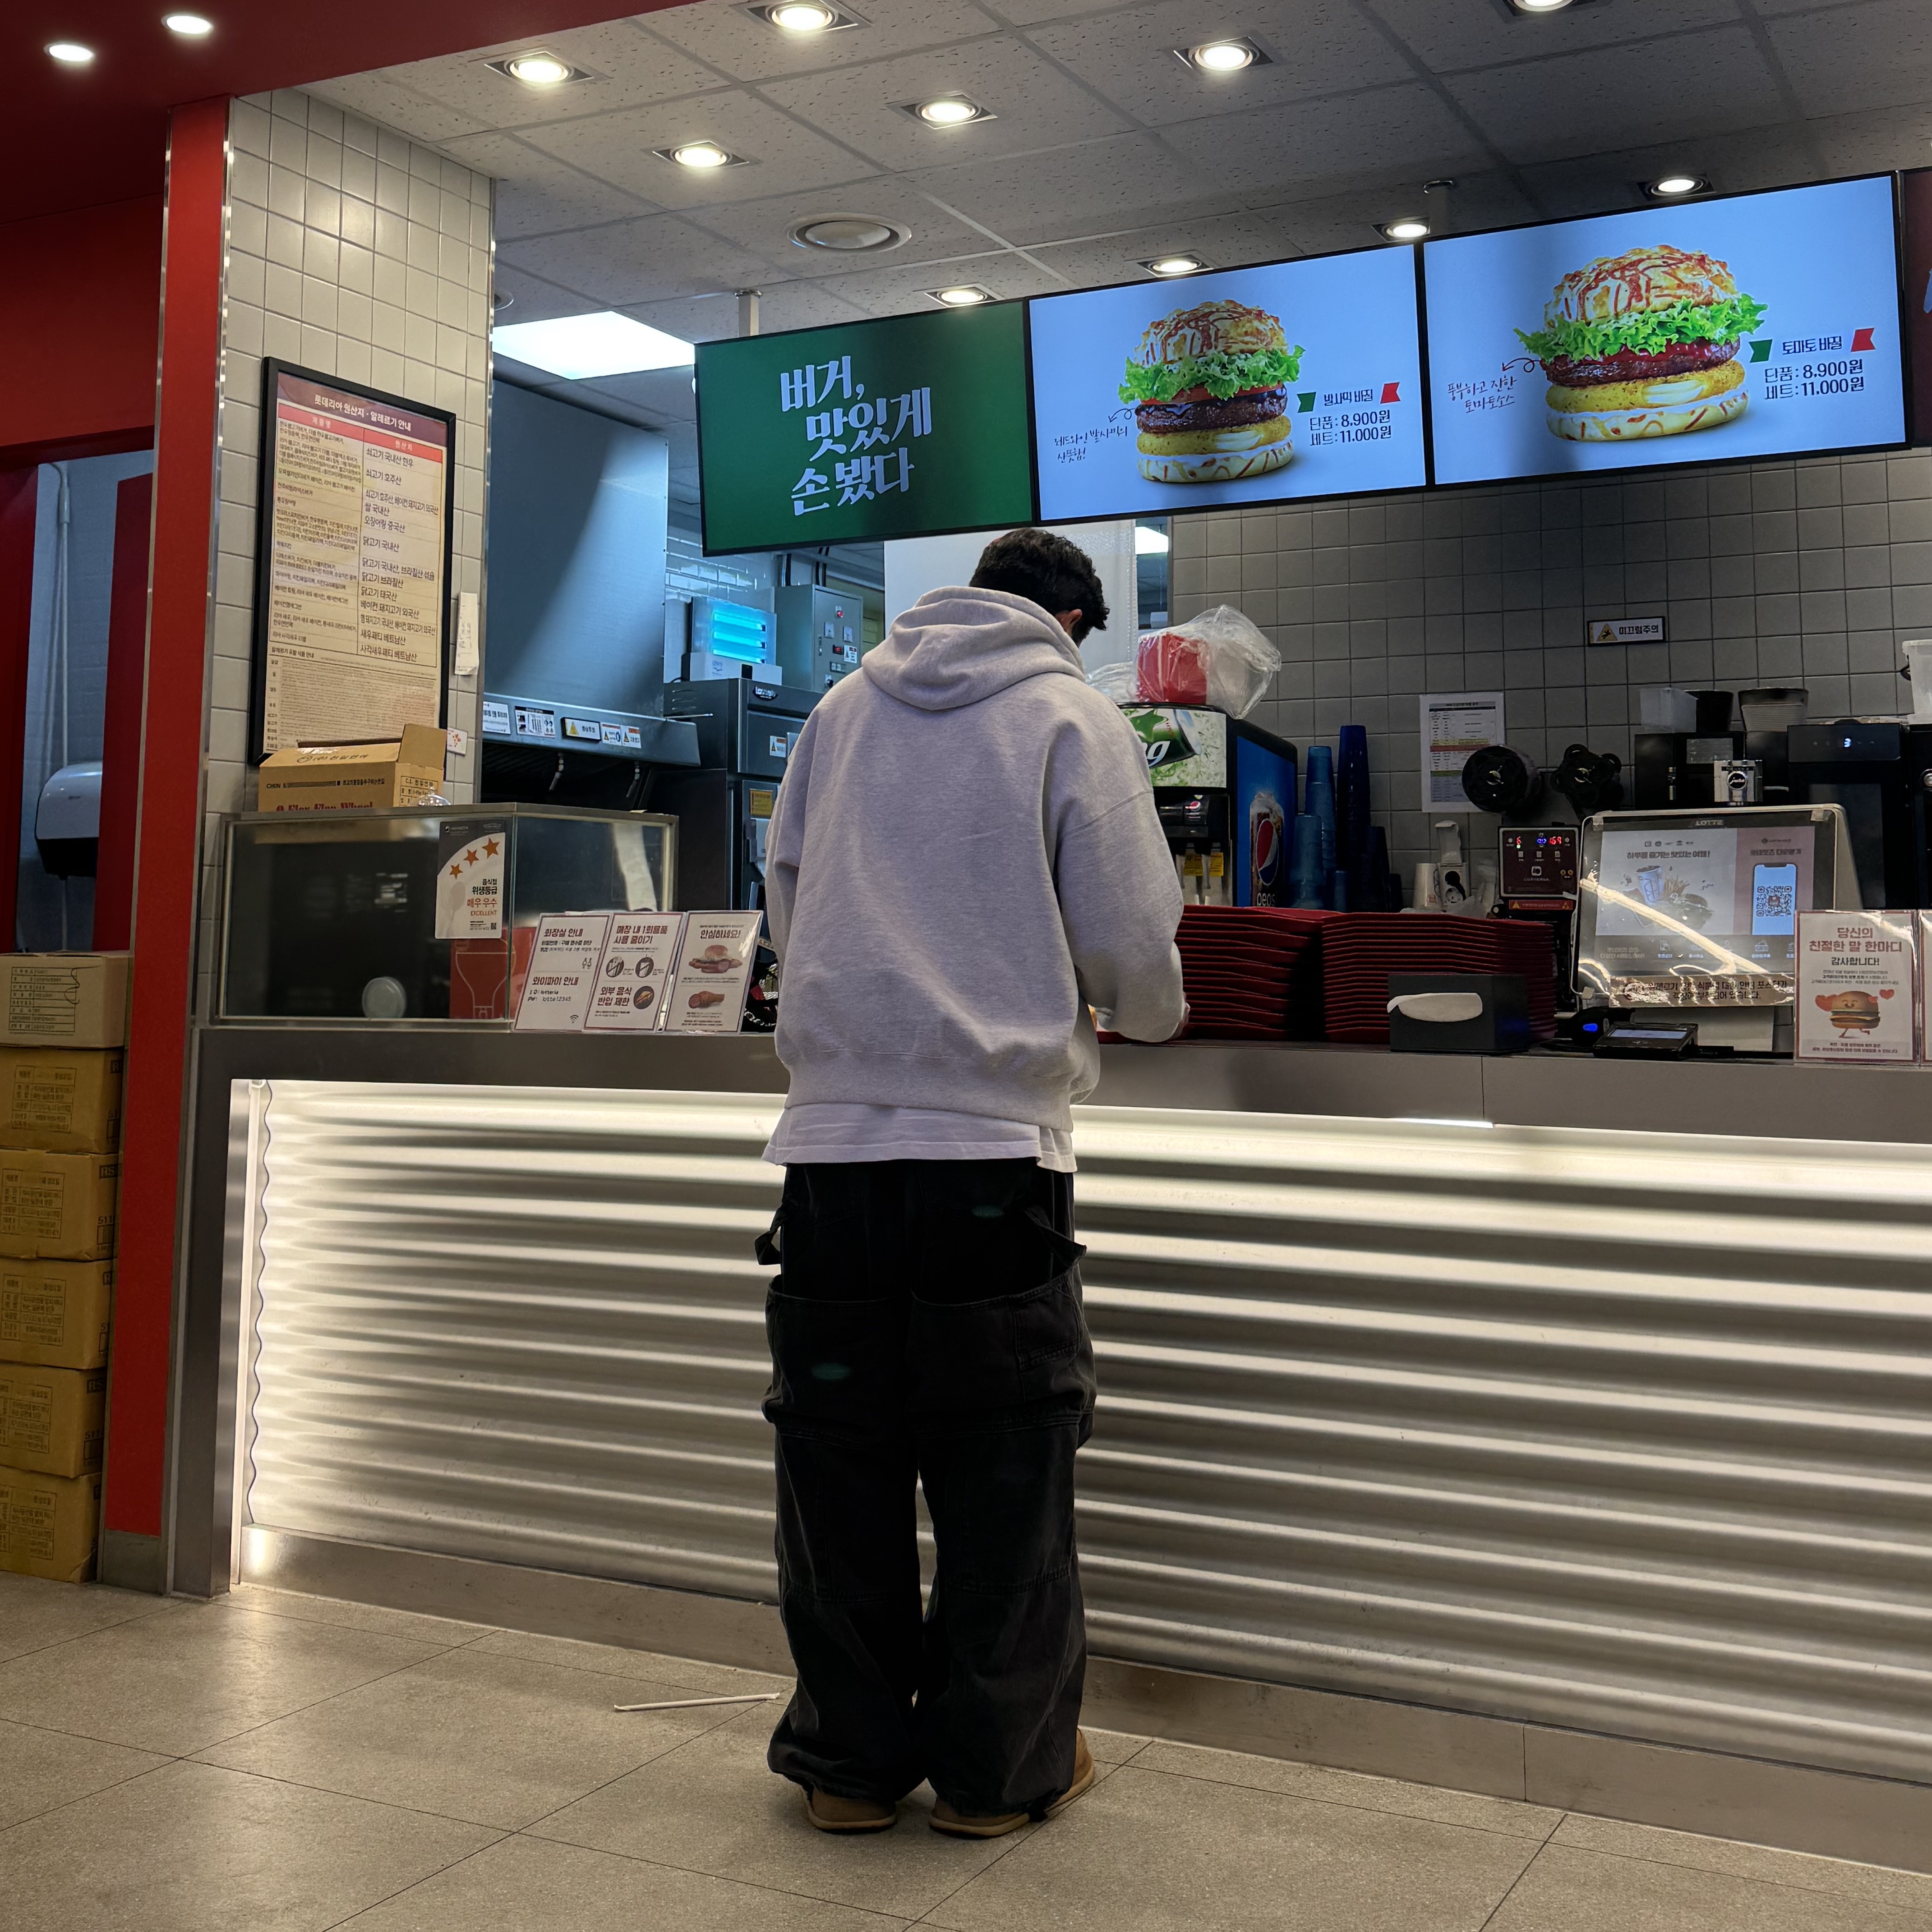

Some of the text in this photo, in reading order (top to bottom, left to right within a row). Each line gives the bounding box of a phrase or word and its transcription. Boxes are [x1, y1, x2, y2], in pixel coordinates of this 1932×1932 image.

[1783, 336, 1842, 355] 토마토 바질
[1803, 359, 1863, 378] 8,900원
[780, 356, 865, 412] 버거,
[1448, 375, 1517, 401] 풍부하고 진한
[1801, 377, 1864, 396] 11,000원
[1324, 389, 1373, 406] 발사믹 바질
[1465, 395, 1515, 414] 토마토소스
[314, 395, 411, 431] 롯데리아 원산지 알레르기 안내
[806, 387, 931, 461] 맛있게
[395, 440, 412, 451] 원산지
[366, 447, 414, 467] 쇠고기 국내산 한우
[366, 468, 383, 480] 쇠고기
[384, 474, 401, 485] 호주산
[791, 447, 914, 515] 손 봤다
[365, 502, 389, 516] 쌀 국내산
[366, 489, 379, 500] 쇠고기
[394, 497, 408, 508] 베이컨
[408, 500, 425, 511] 돼지고기
[426, 504, 438, 515] 외국산
[364, 516, 405, 533] 오징어링 중국산
[363, 536, 399, 552] 닭고기 국내산
[362, 557, 434, 581] 닭고기 국내산, 브라질산 섞음
[362, 572, 403, 589] 닭고기 브라질산
[361, 586, 397, 602] 닭고기 태국산
[361, 600, 419, 620] 베이컨 돼지고기 외국산
[361, 629, 406, 645] 새우패티 베트남산
[407, 623, 423, 634] 돼지고기
[424, 625, 436, 635] 외국산
[1619, 625, 1658, 635] 미끄럼주의
[361, 644, 417, 662] 사각새우패티 베트남산
[472, 886, 498, 895] 위생등급
[467, 898, 498, 908] 매우 우수
[1257, 892, 1277, 906] peps
[544, 929, 583, 937] 화장실 안내
[616, 925, 668, 934] 매장 내 1회용품
[700, 929, 741, 939] 안심하세요!
[1837, 927, 1873, 938] 당신의
[613, 935, 653, 944] 사용 줄이기
[1809, 940, 1902, 952] 친절한 말 한마디
[1831, 957, 1880, 966] 감사합니다!
[532, 977, 579, 985] 와이파이 안내
[600, 986, 632, 996] 외부 음식
[598, 998, 630, 1006] 반입 제한
[98, 1216, 114, 1224] 511
